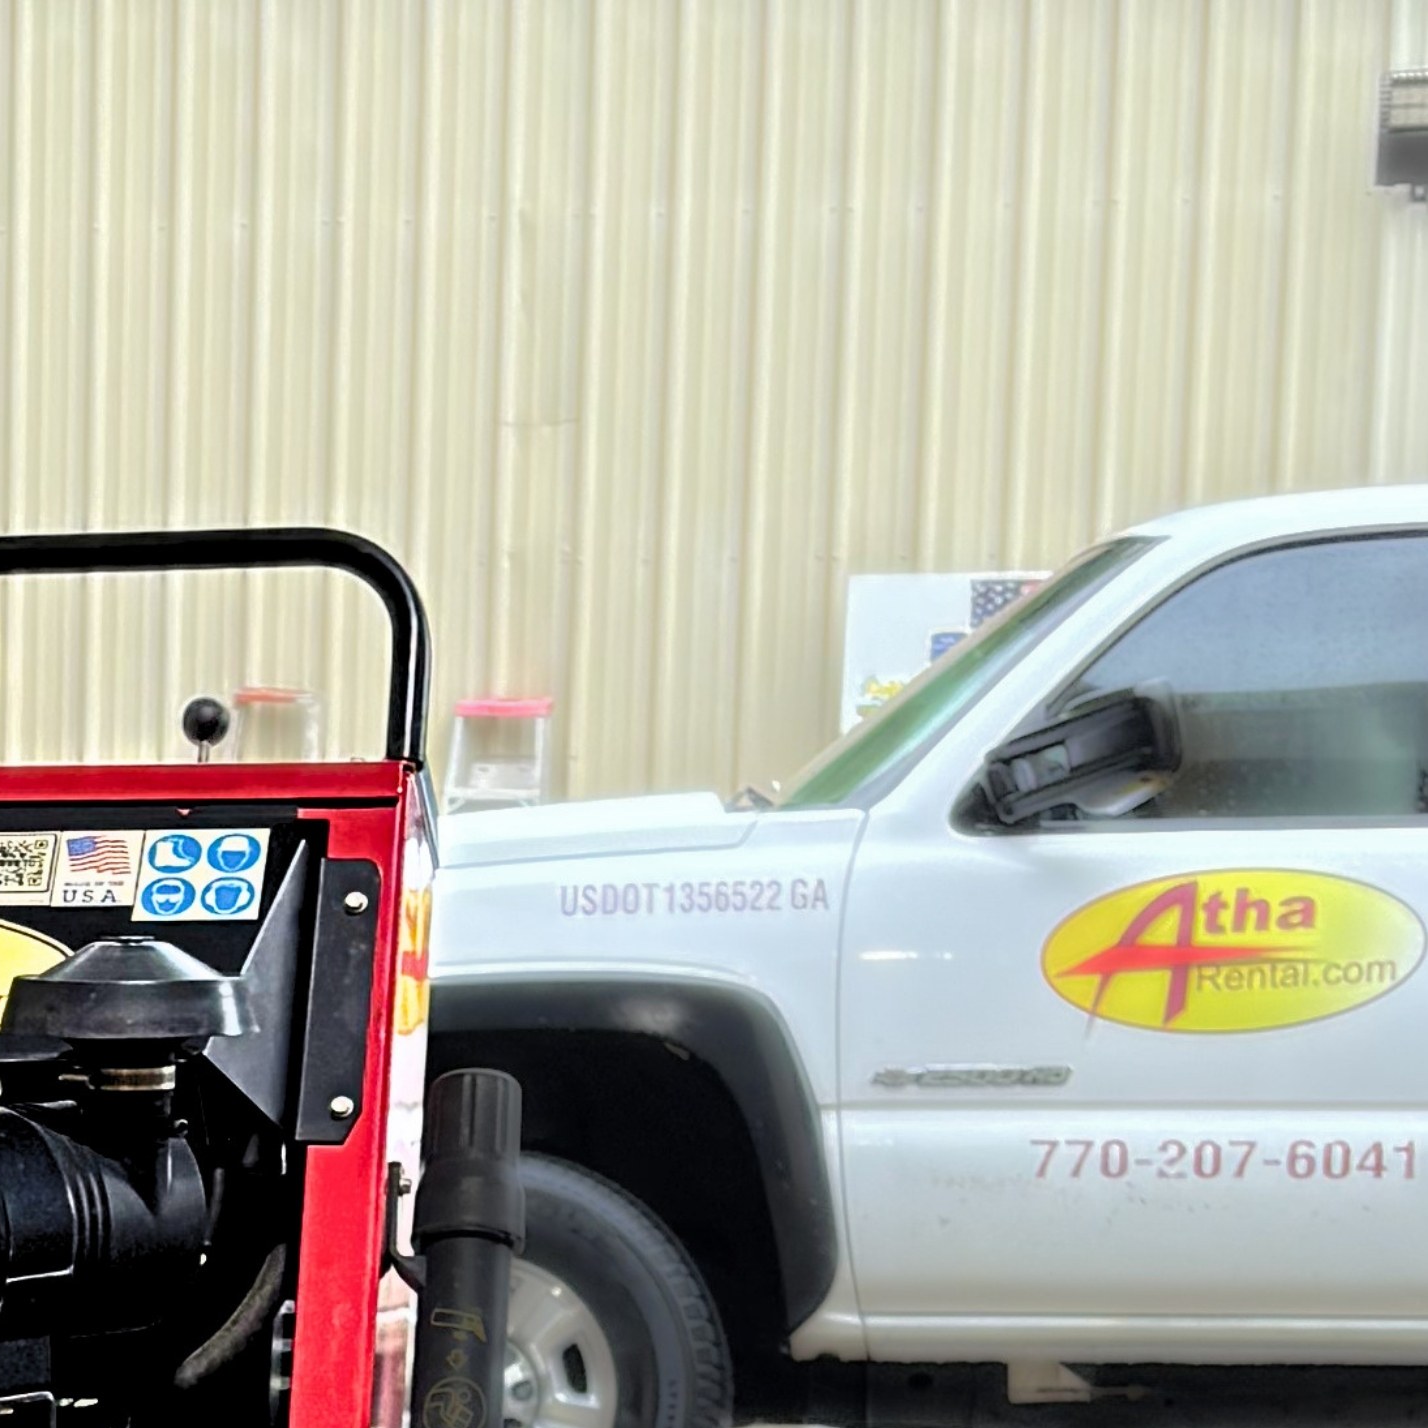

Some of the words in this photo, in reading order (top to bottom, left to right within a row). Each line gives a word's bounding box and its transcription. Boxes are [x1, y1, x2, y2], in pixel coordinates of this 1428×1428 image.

[560, 880, 782, 917] USDOT1356522
[790, 878, 830, 911] GA
[1055, 879, 1317, 1030] Atha
[1195, 958, 1398, 993] Rental.com
[1030, 1138, 1417, 1181] 770-207-6041
